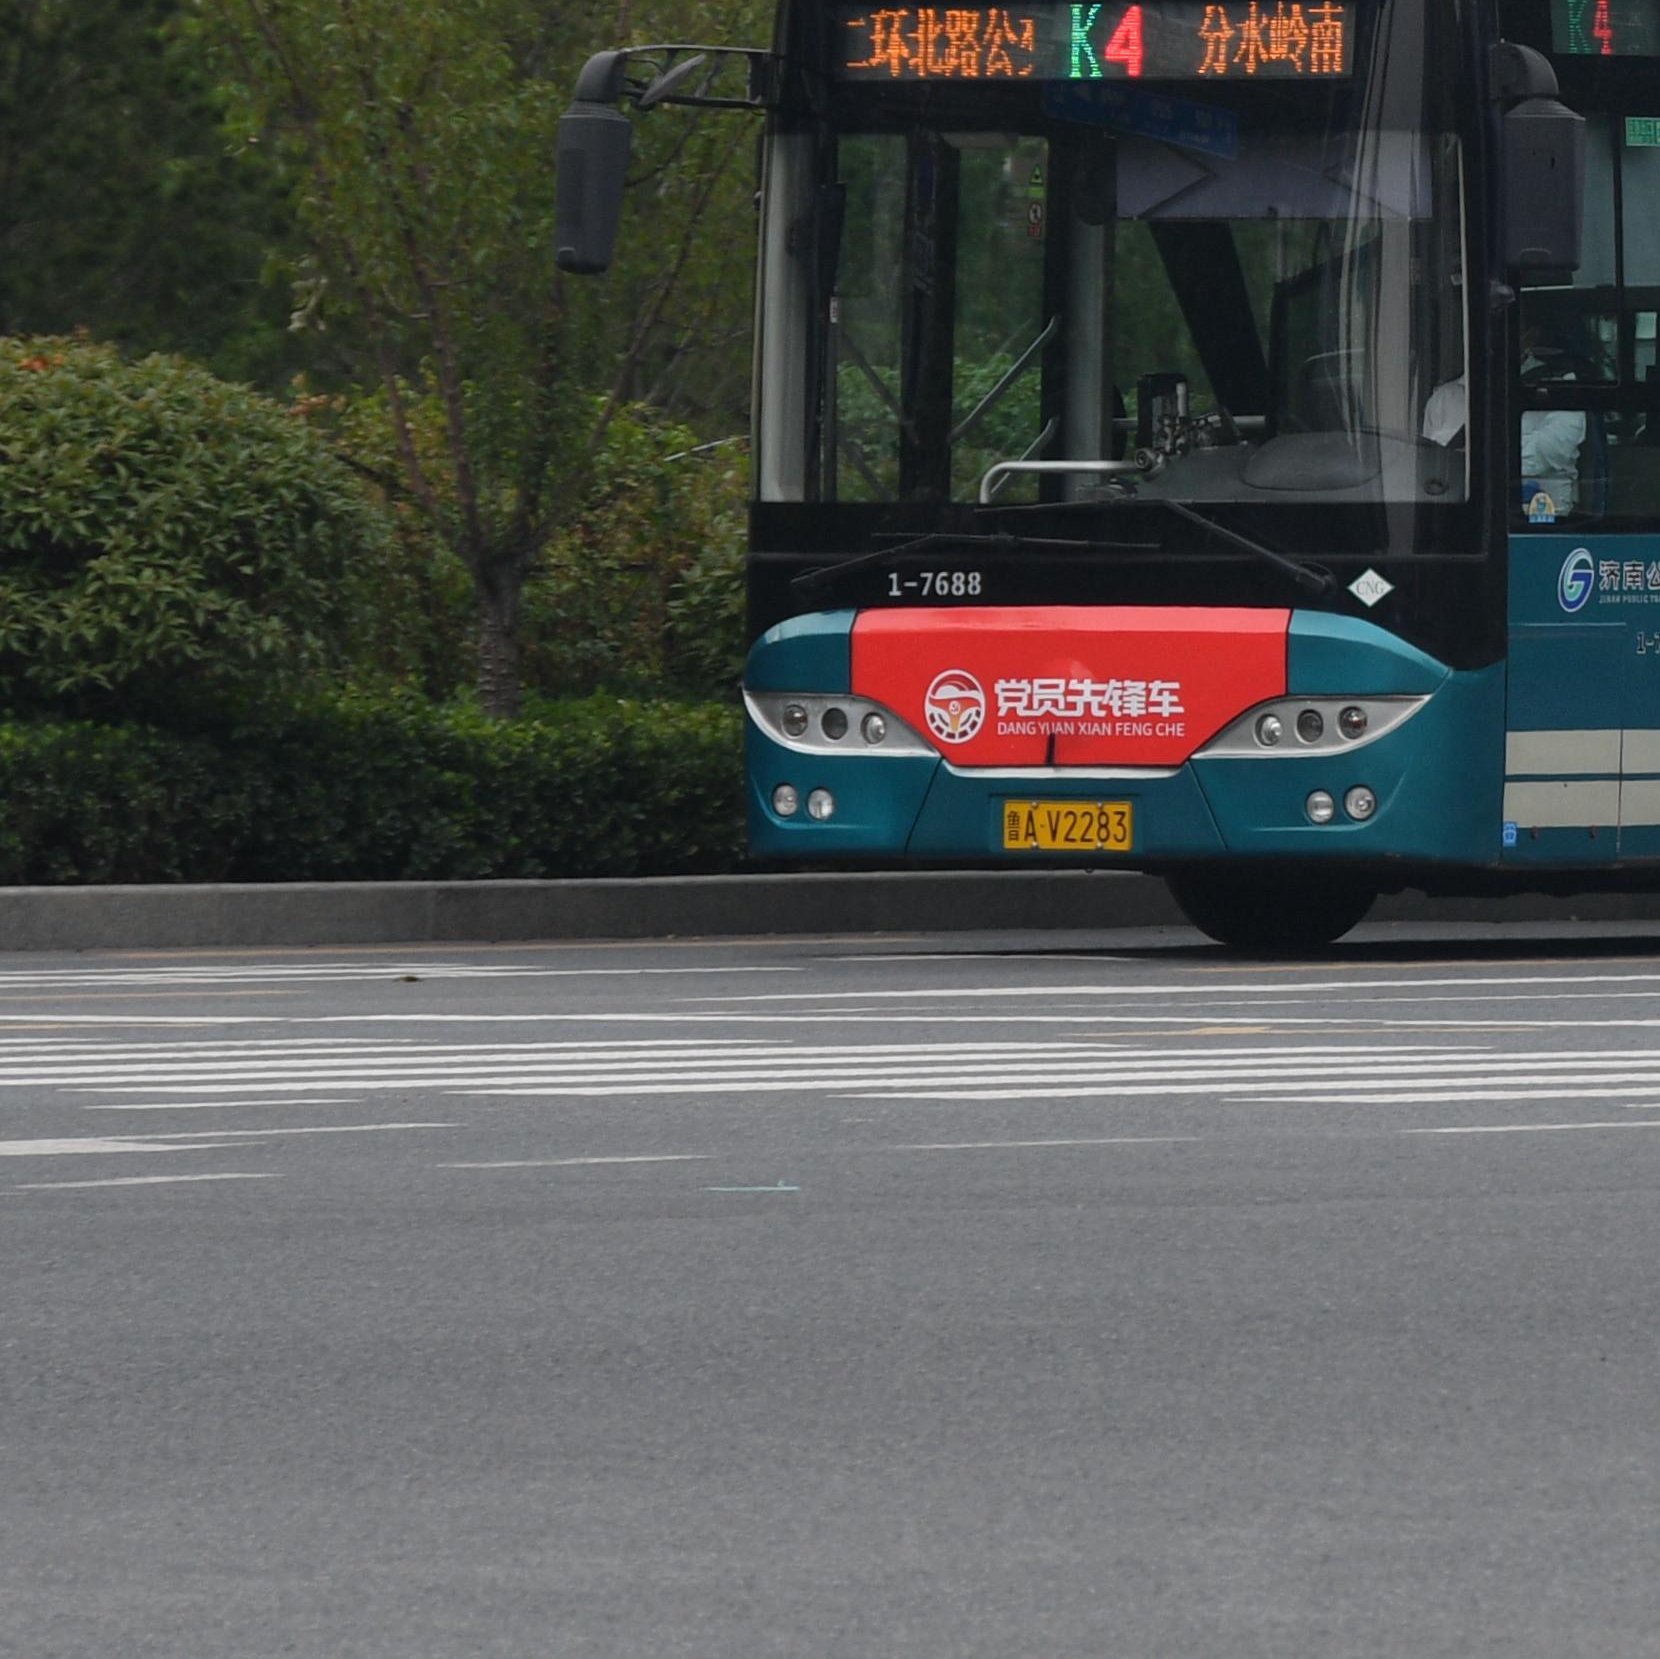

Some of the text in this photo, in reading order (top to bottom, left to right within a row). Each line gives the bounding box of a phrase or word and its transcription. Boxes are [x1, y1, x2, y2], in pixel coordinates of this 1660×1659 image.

[1069, 3, 1144, 78] K4
[1197, 0, 1345, 75] 分水岭南
[887, 571, 982, 597] 1-7688
[1356, 579, 1385, 596] CNG
[994, 678, 1185, 718] 党员先锋车
[997, 721, 1185, 737] DANG YUAN XIAN FENG CHE
